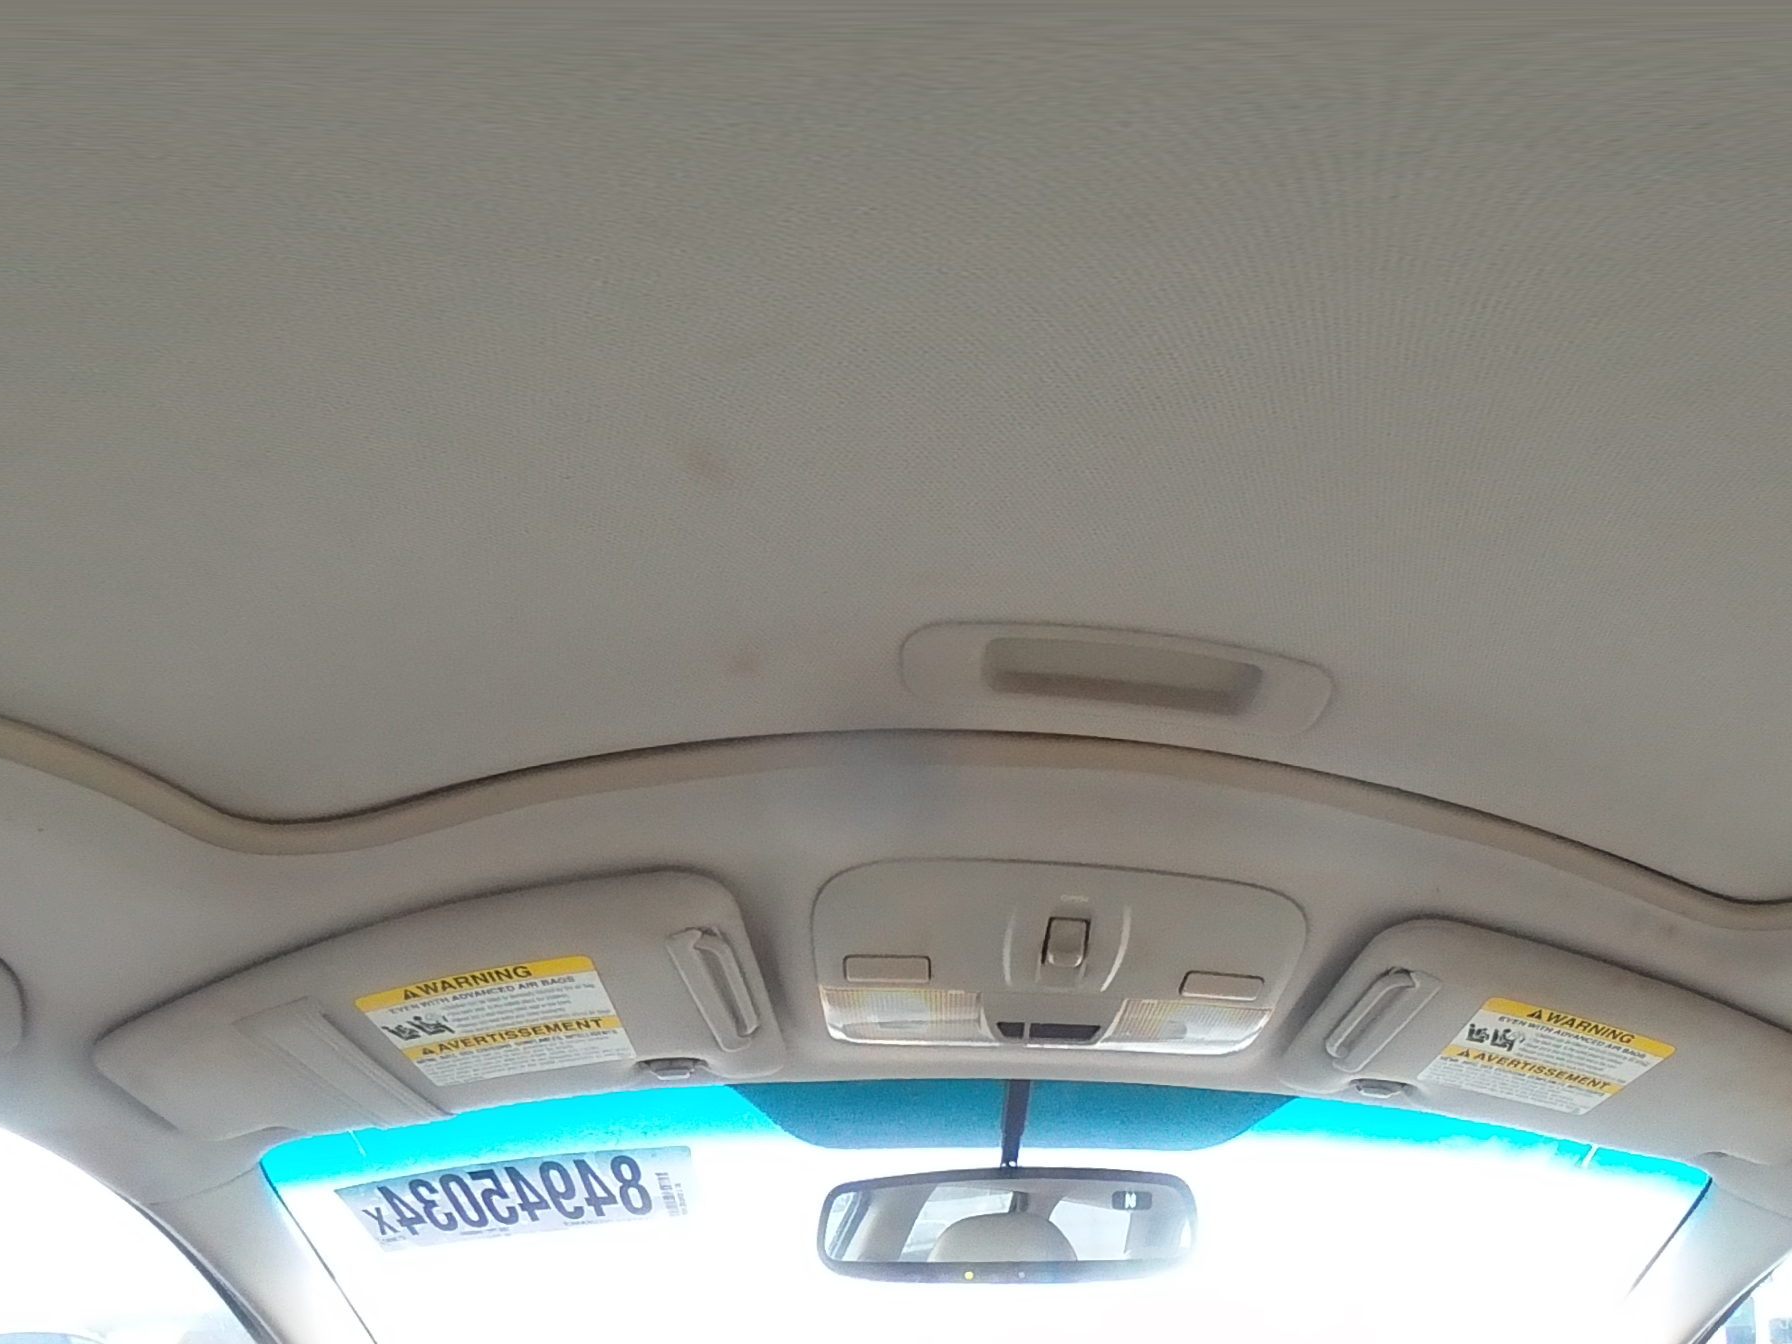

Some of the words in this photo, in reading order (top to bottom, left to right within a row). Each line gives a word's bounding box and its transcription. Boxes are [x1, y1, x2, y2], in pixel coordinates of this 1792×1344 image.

[416, 965, 533, 996] WARNING
[451, 983, 515, 1002] ADVANCED
[437, 1017, 604, 1053] AVERTISSEMENT
[1546, 1011, 1636, 1045] WARNING
[1472, 1051, 1611, 1090] AVERTISSEMENT
